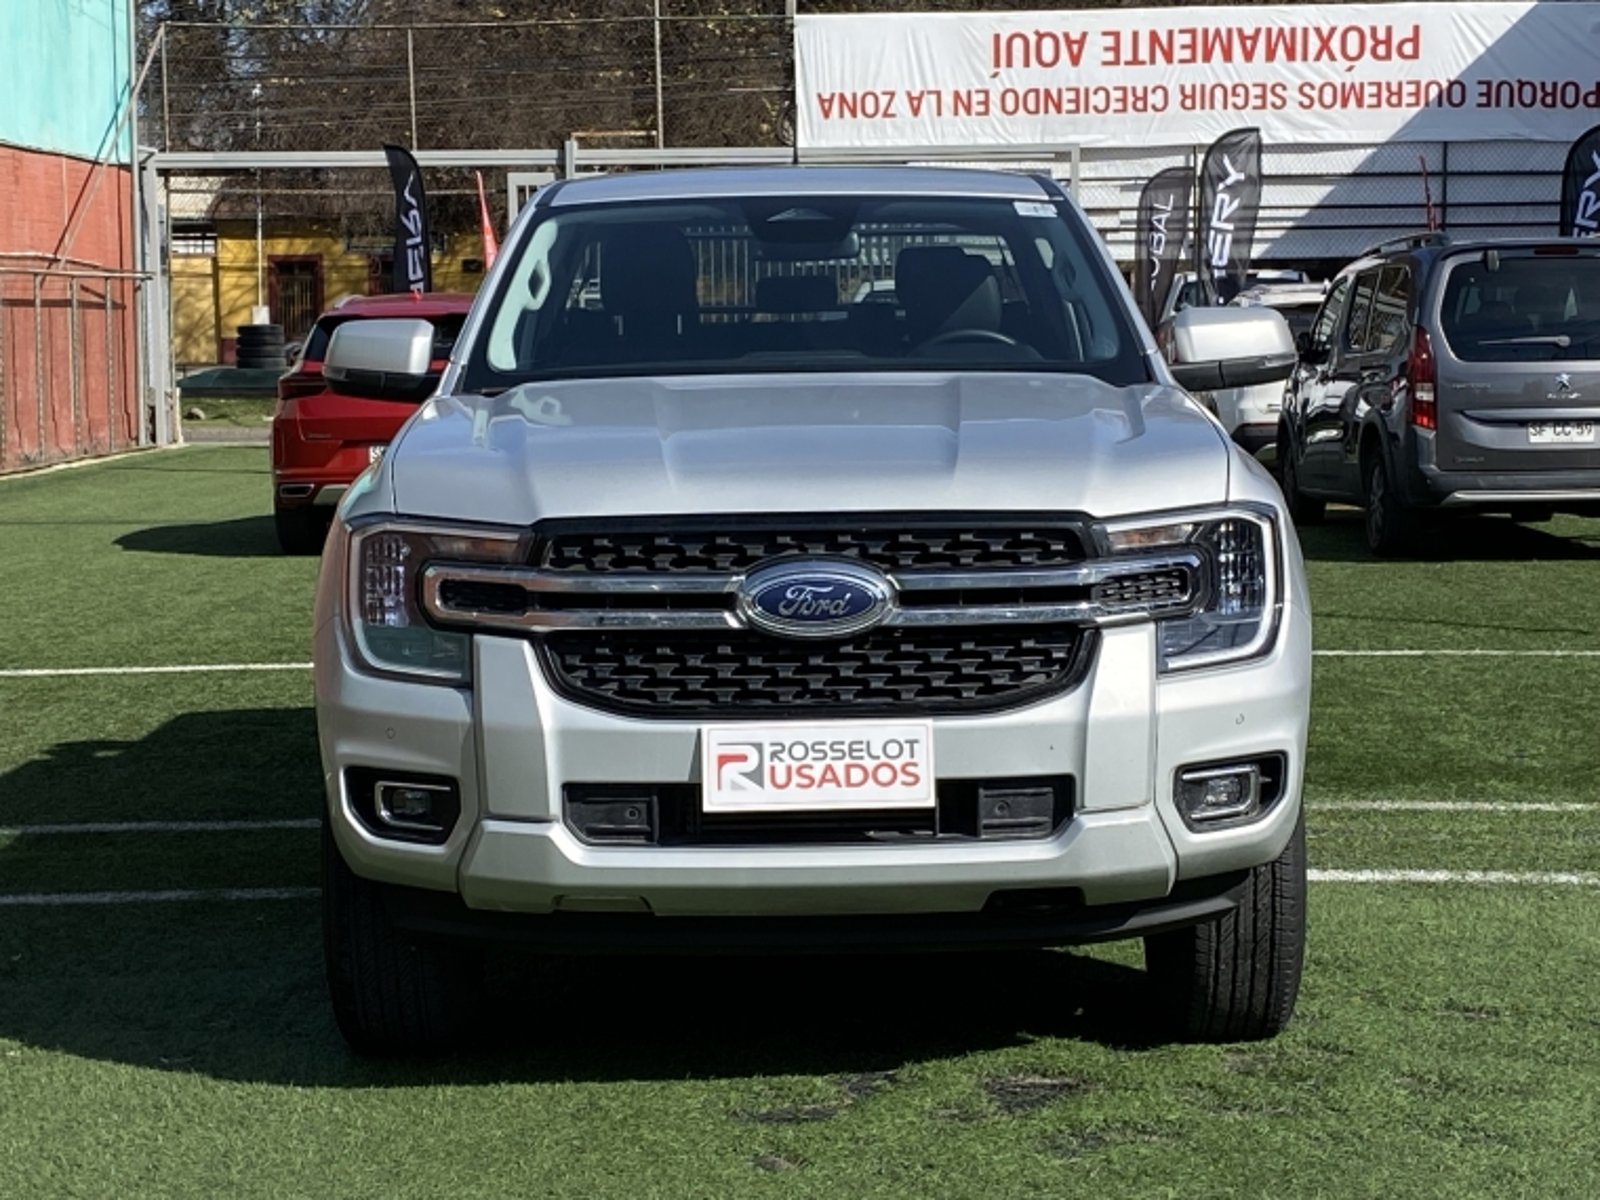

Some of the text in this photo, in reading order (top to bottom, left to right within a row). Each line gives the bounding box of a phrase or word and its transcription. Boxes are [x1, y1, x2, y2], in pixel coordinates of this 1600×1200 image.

[990, 23, 1421, 78] PRÓXIMAMENTE AQUÍ
[817, 79, 1600, 120] PORQUE QUEREMOS SEGUIR CRECIENDO EN LA ZONA
[778, 585, 852, 616] Ford
[770, 739, 920, 762] ROSSELOT
[770, 762, 921, 789] USADOS
